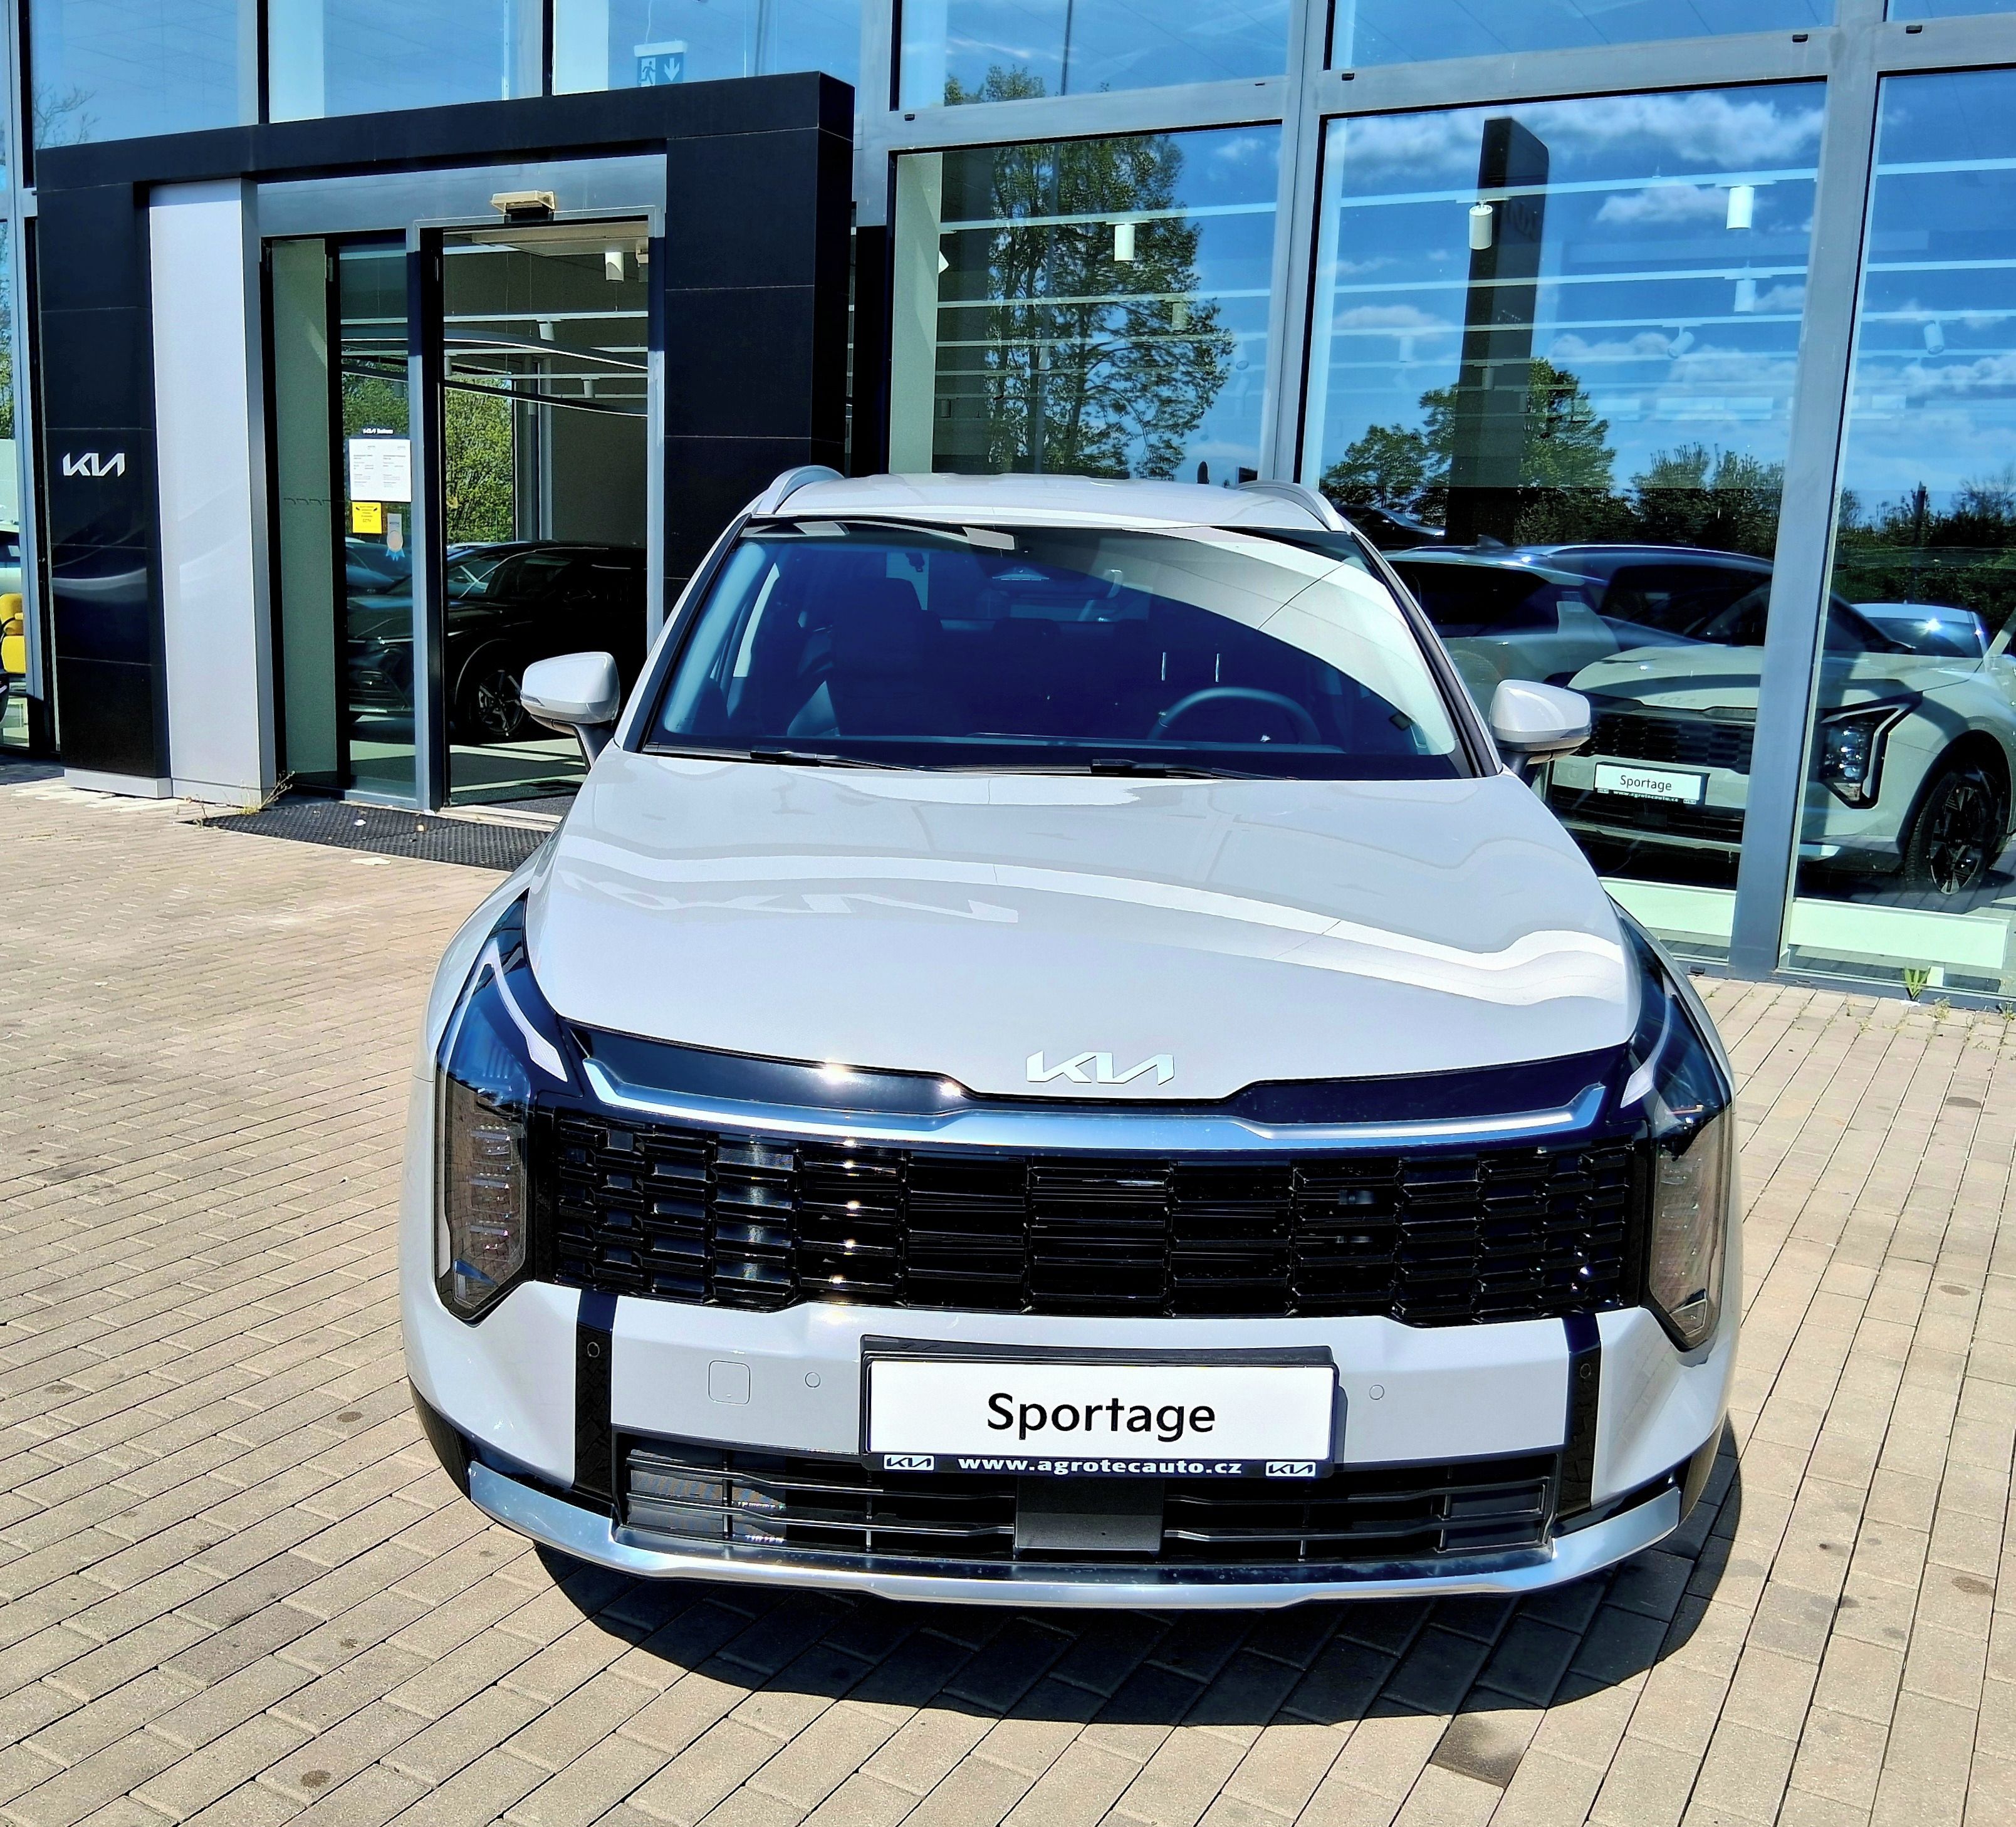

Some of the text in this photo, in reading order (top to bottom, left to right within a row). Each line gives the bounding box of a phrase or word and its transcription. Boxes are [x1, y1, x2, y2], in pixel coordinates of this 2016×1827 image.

[63, 453, 125, 476] KIA
[1620, 775, 1672, 792] Sportage
[1026, 1050, 1174, 1086] KIA
[987, 1392, 1216, 1442] Sportage
[886, 1456, 1314, 1475] KIA www.agrotecauto.cz KIA
